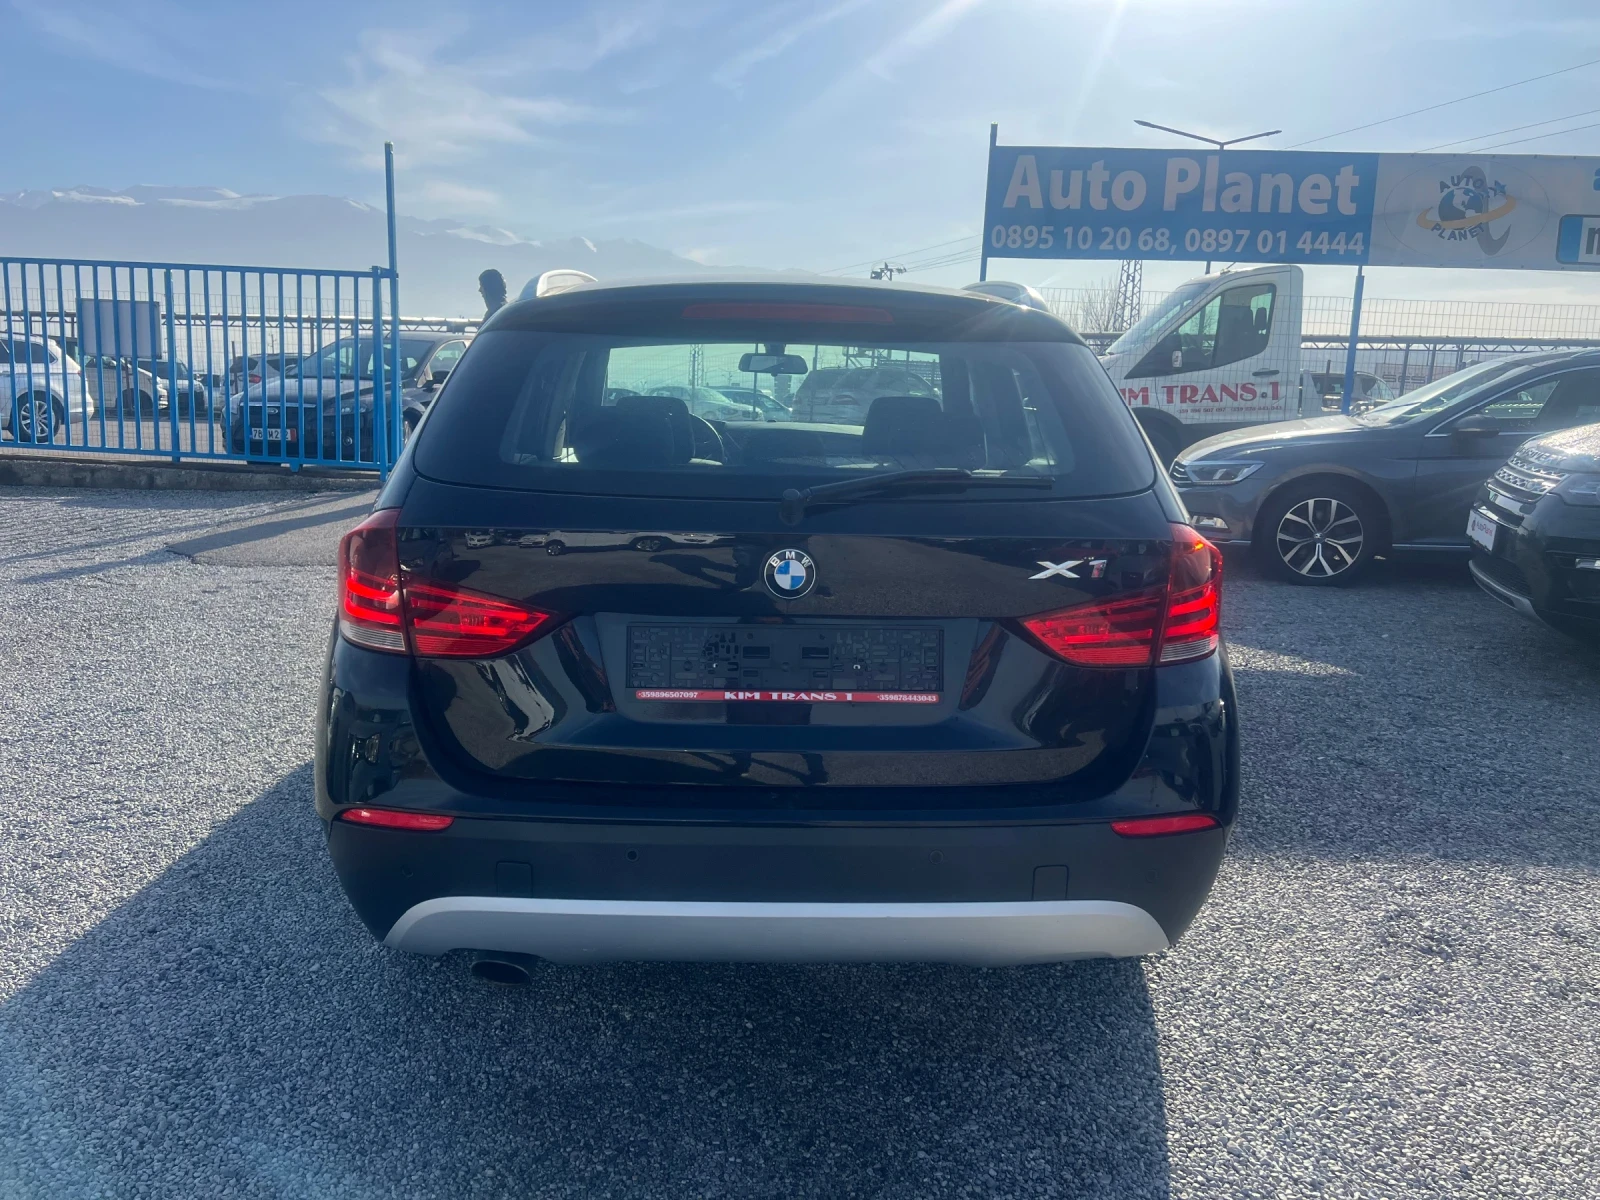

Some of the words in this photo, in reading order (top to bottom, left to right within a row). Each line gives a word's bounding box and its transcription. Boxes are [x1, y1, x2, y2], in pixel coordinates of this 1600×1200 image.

[1003, 155, 1147, 211] Auto
[1163, 155, 1360, 216] Planet
[1440, 175, 1485, 193] AUTO
[991, 225, 1054, 249] 0895
[1064, 226, 1093, 250] 10
[1099, 227, 1132, 251] 20
[1138, 228, 1177, 255] 68,
[1184, 228, 1251, 252] 0897
[1257, 230, 1287, 254] 01
[1296, 231, 1365, 255] 4444
[1431, 222, 1486, 241] PLANET
[769, 551, 812, 568] BMW
[1028, 559, 1108, 580] X1
[724, 691, 761, 700] KIM
[769, 692, 837, 701] TRANS
[845, 692, 853, 701] 1
